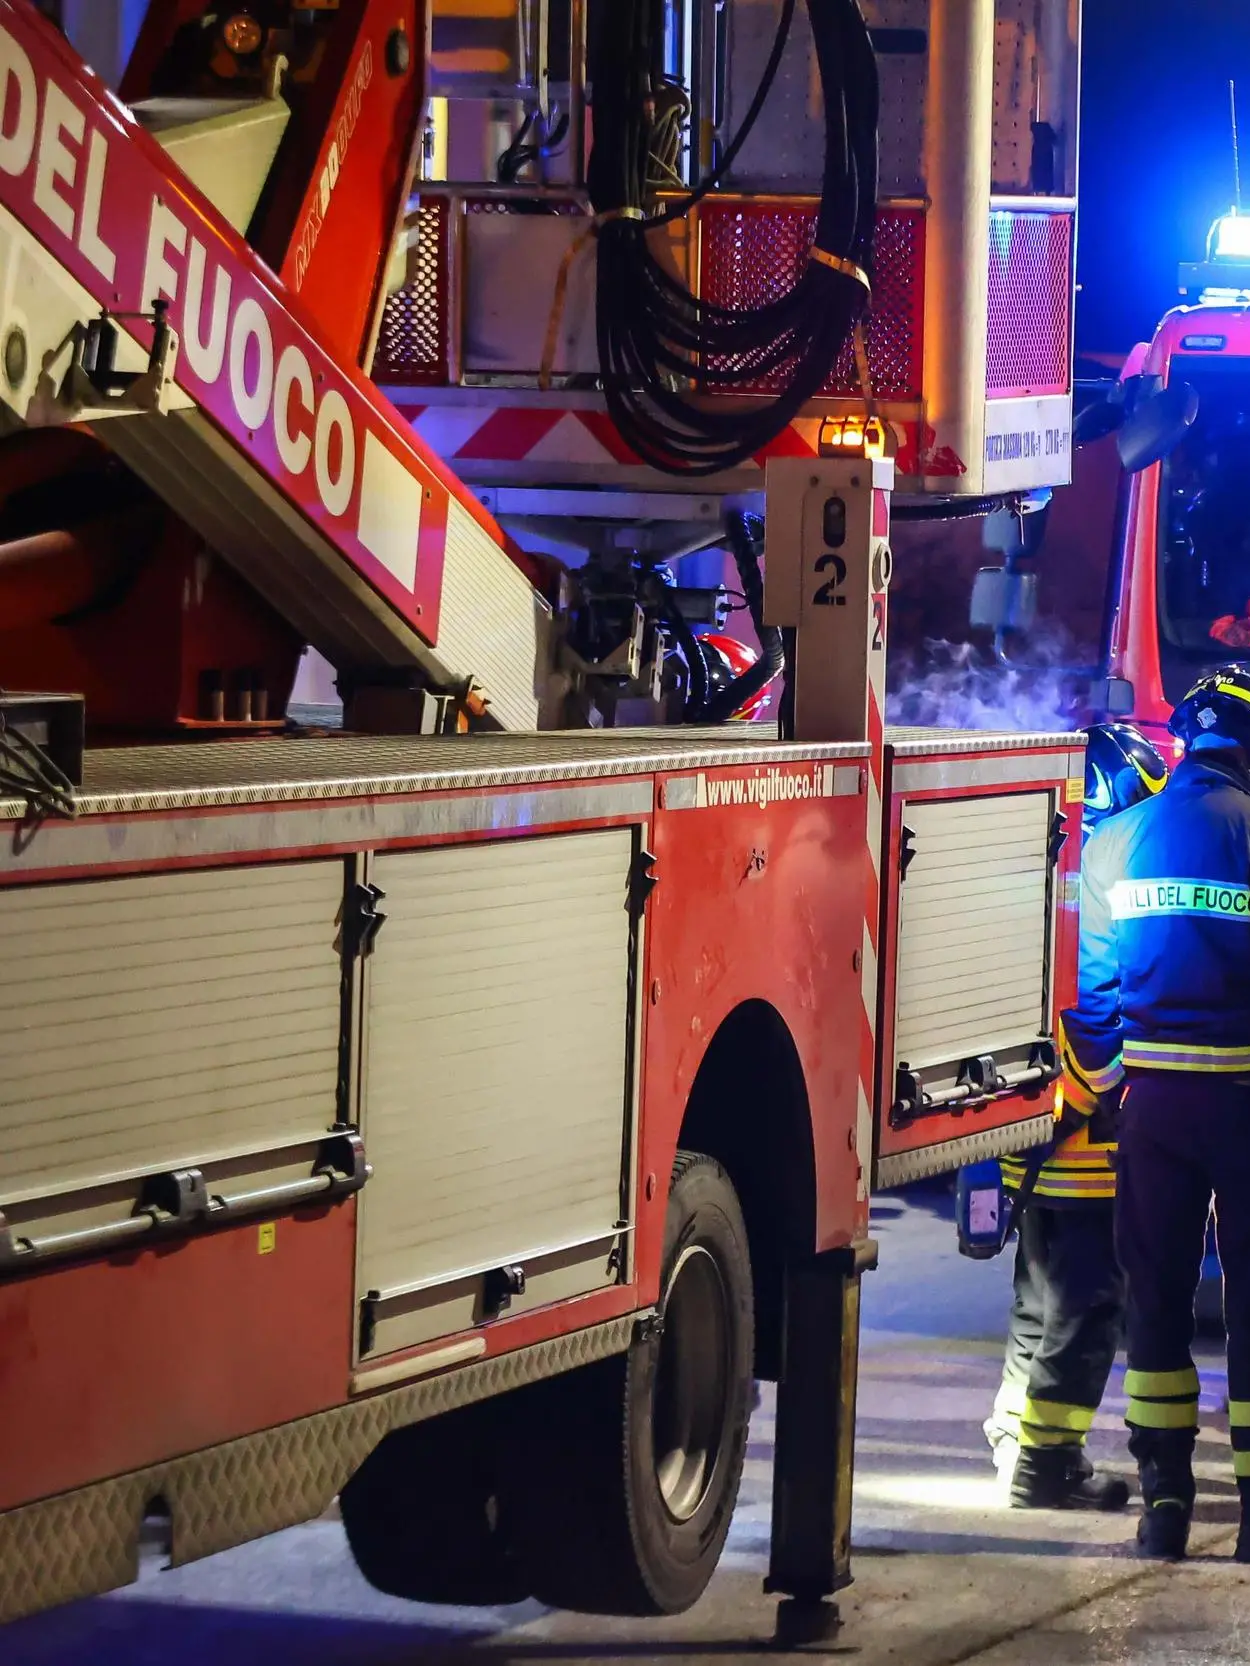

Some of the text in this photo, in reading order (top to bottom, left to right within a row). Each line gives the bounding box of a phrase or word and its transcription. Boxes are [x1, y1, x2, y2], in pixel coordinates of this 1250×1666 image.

[0, 24, 116, 284] DEL
[141, 194, 355, 517] FUOCO
[707, 762, 821, 809] www.vigilfuoco.it
[1157, 886, 1186, 906] DEL
